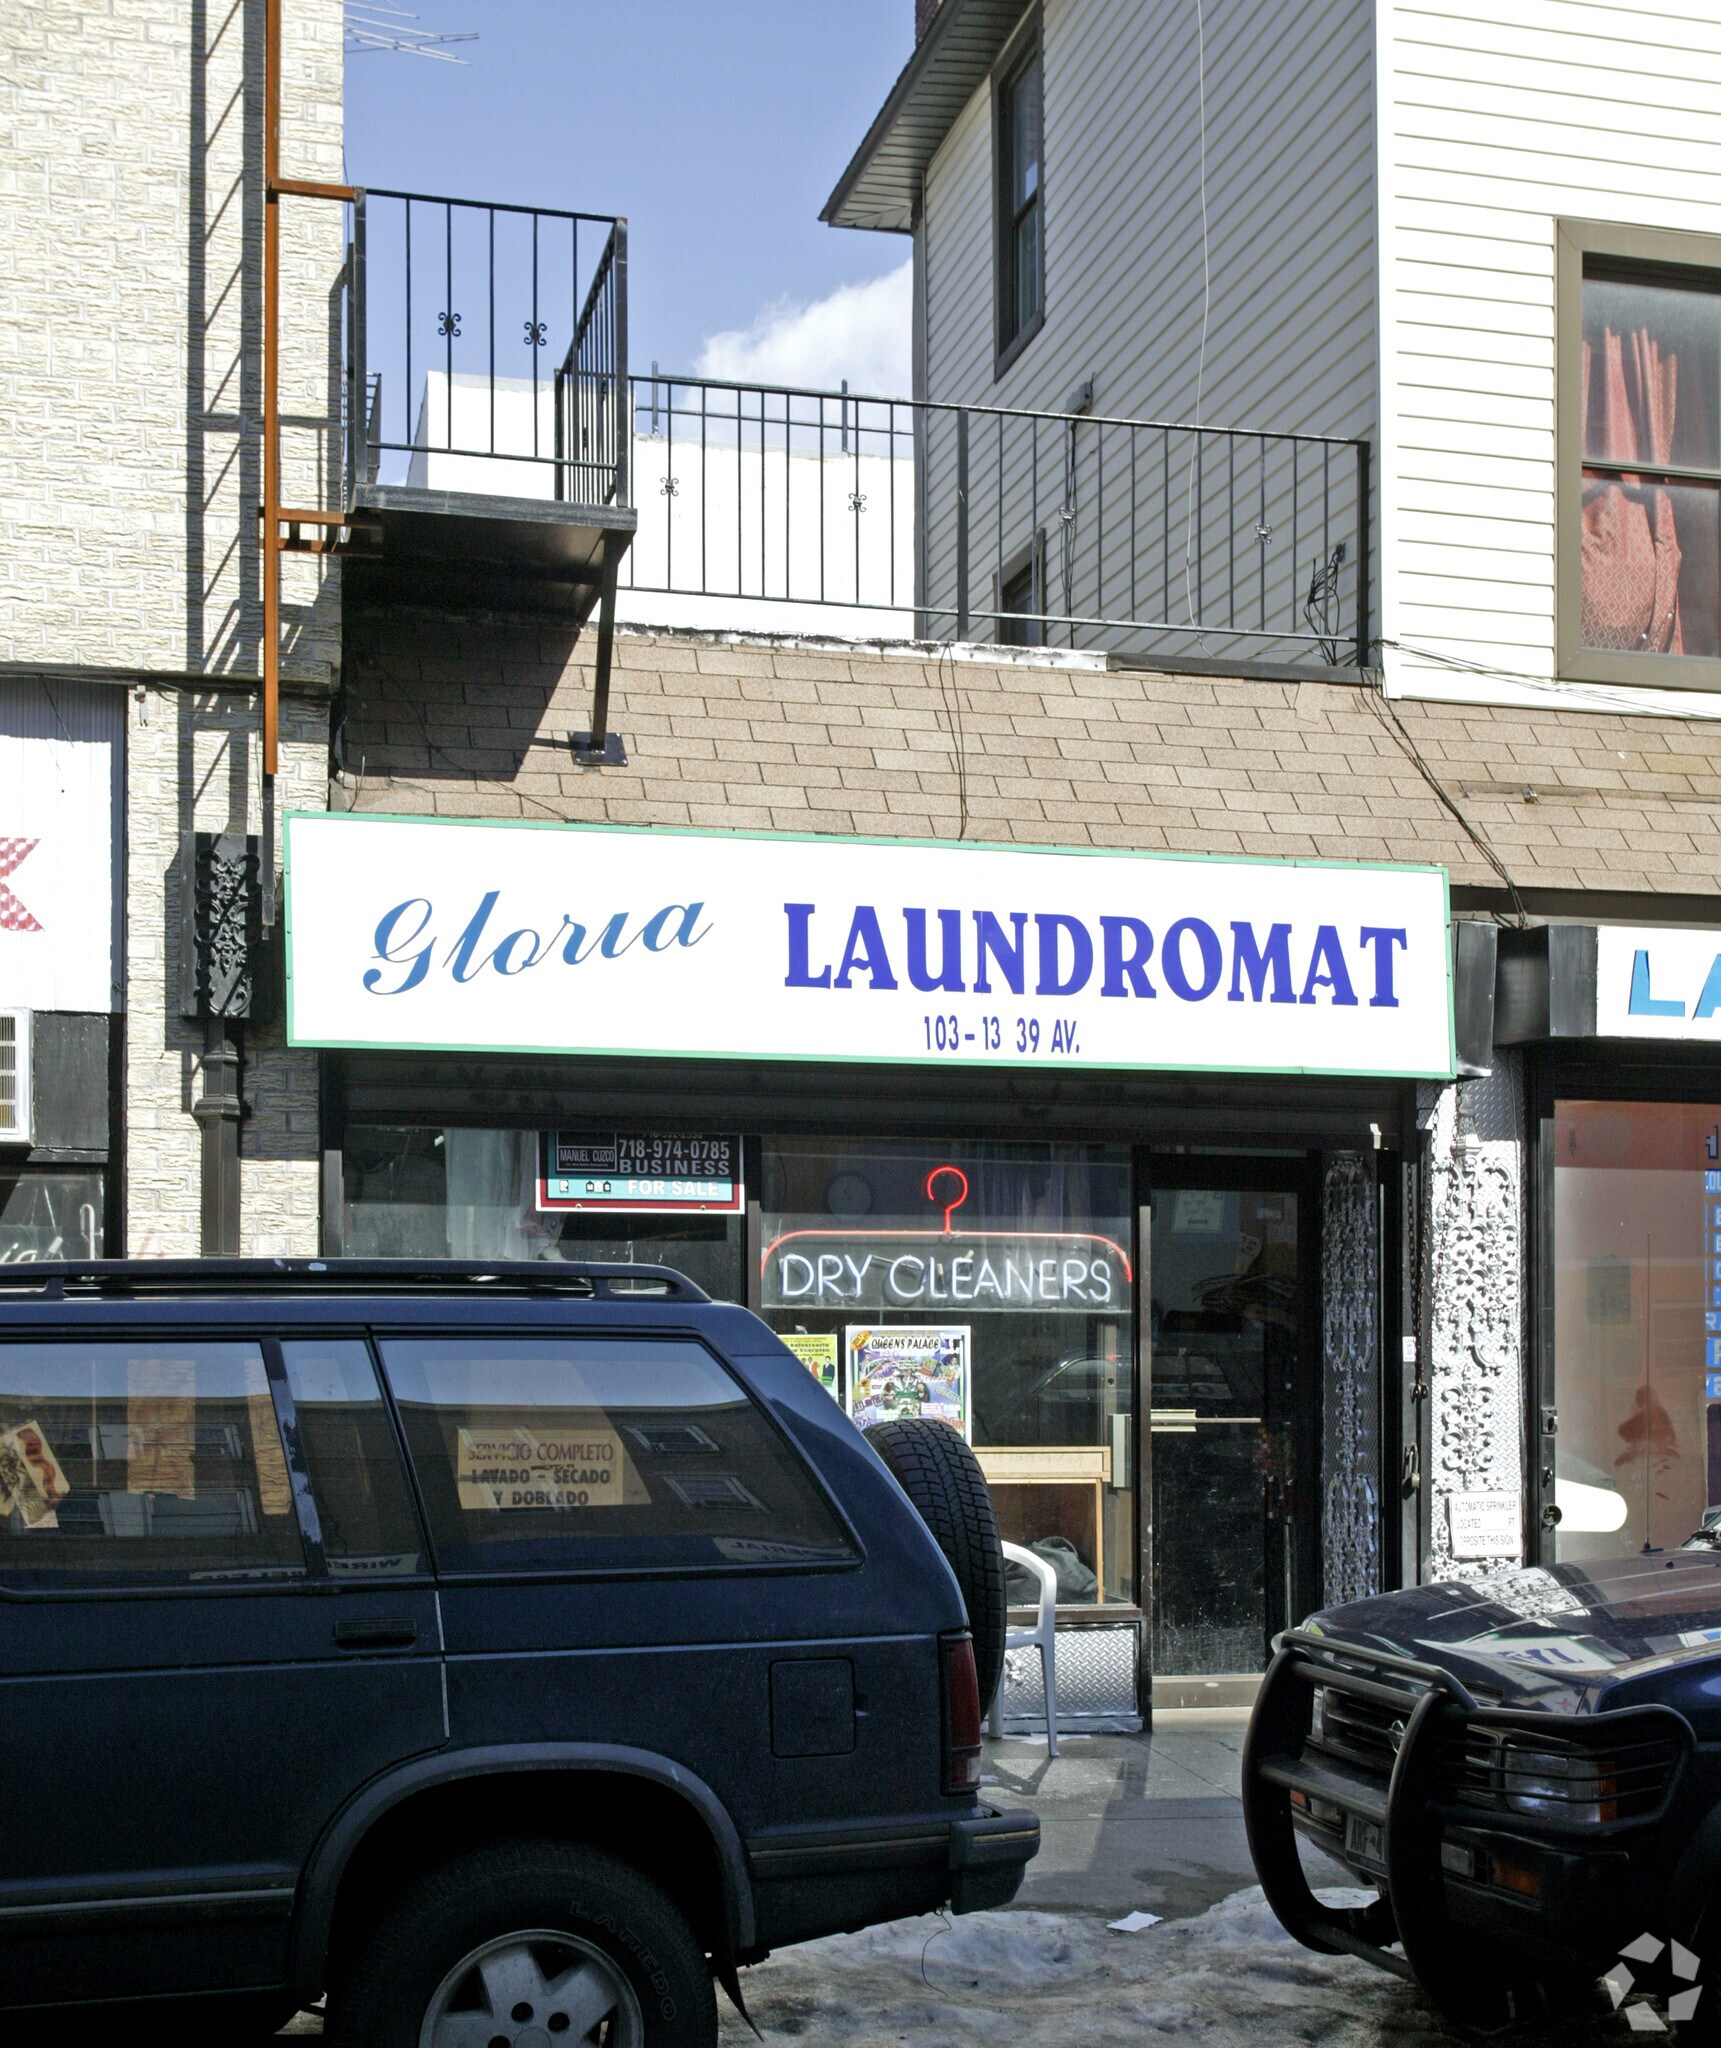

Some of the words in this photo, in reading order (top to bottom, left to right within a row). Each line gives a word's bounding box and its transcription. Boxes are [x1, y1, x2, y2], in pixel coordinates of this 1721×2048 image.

[362, 890, 714, 996] Gloria
[784, 902, 1408, 1008] LAUNDROMAT
[1016, 1017, 1040, 1053] 39
[1050, 1019, 1080, 1054] AV.
[560, 1149, 589, 1162] MANUEL
[592, 1150, 614, 1162] CUZCO
[619, 1139, 730, 1159] 718-974-0785
[620, 1159, 730, 1175] BUSINESS
[627, 1180, 666, 1196] FOR
[671, 1181, 719, 1196] SALE
[780, 1254, 874, 1299] DRY
[889, 1254, 1112, 1301] CLEANERS
[871, 1338, 904, 1350] QUEENS
[906, 1338, 939, 1350] PALACE
[467, 1443, 531, 1461] SERVICIO
[536, 1443, 614, 1462] COMPLETO
[471, 1468, 531, 1485] LAVADO
[553, 1468, 611, 1484] SECADO
[493, 1490, 503, 1506] Y
[511, 1490, 589, 1505] DOBLADO
[1486, 1500, 1517, 1511] SPRINKLER
[1456, 1518, 1481, 1529] LOCATED
[1508, 1517, 1515, 1528] FT
[1486, 1535, 1500, 1545] THIS
[1500, 1534, 1514, 1545] SIGN
[569, 1901, 677, 2021] LAREDO
